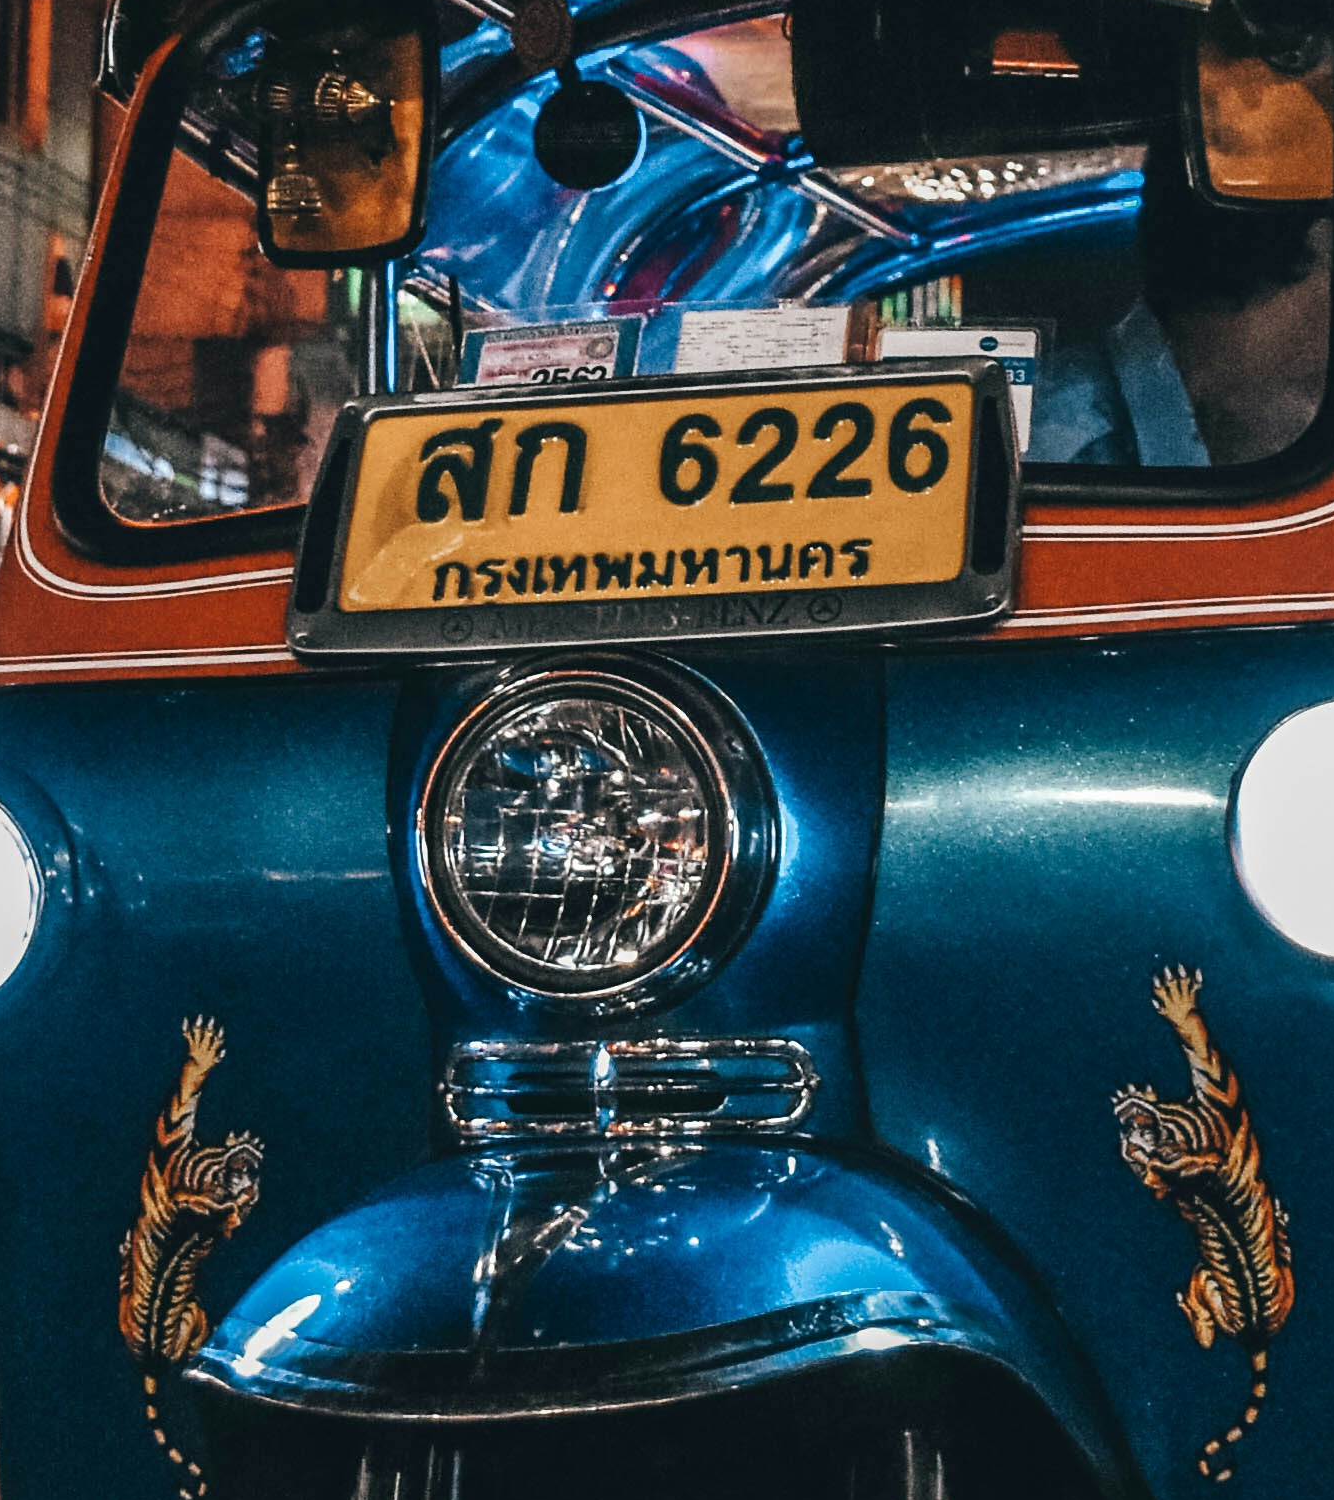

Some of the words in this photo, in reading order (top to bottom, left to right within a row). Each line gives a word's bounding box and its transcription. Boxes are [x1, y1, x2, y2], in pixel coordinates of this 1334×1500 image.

[416, 416, 589, 527] สก
[658, 397, 954, 507] 6226
[432, 538, 873, 602] กรงเทพมหานคร
